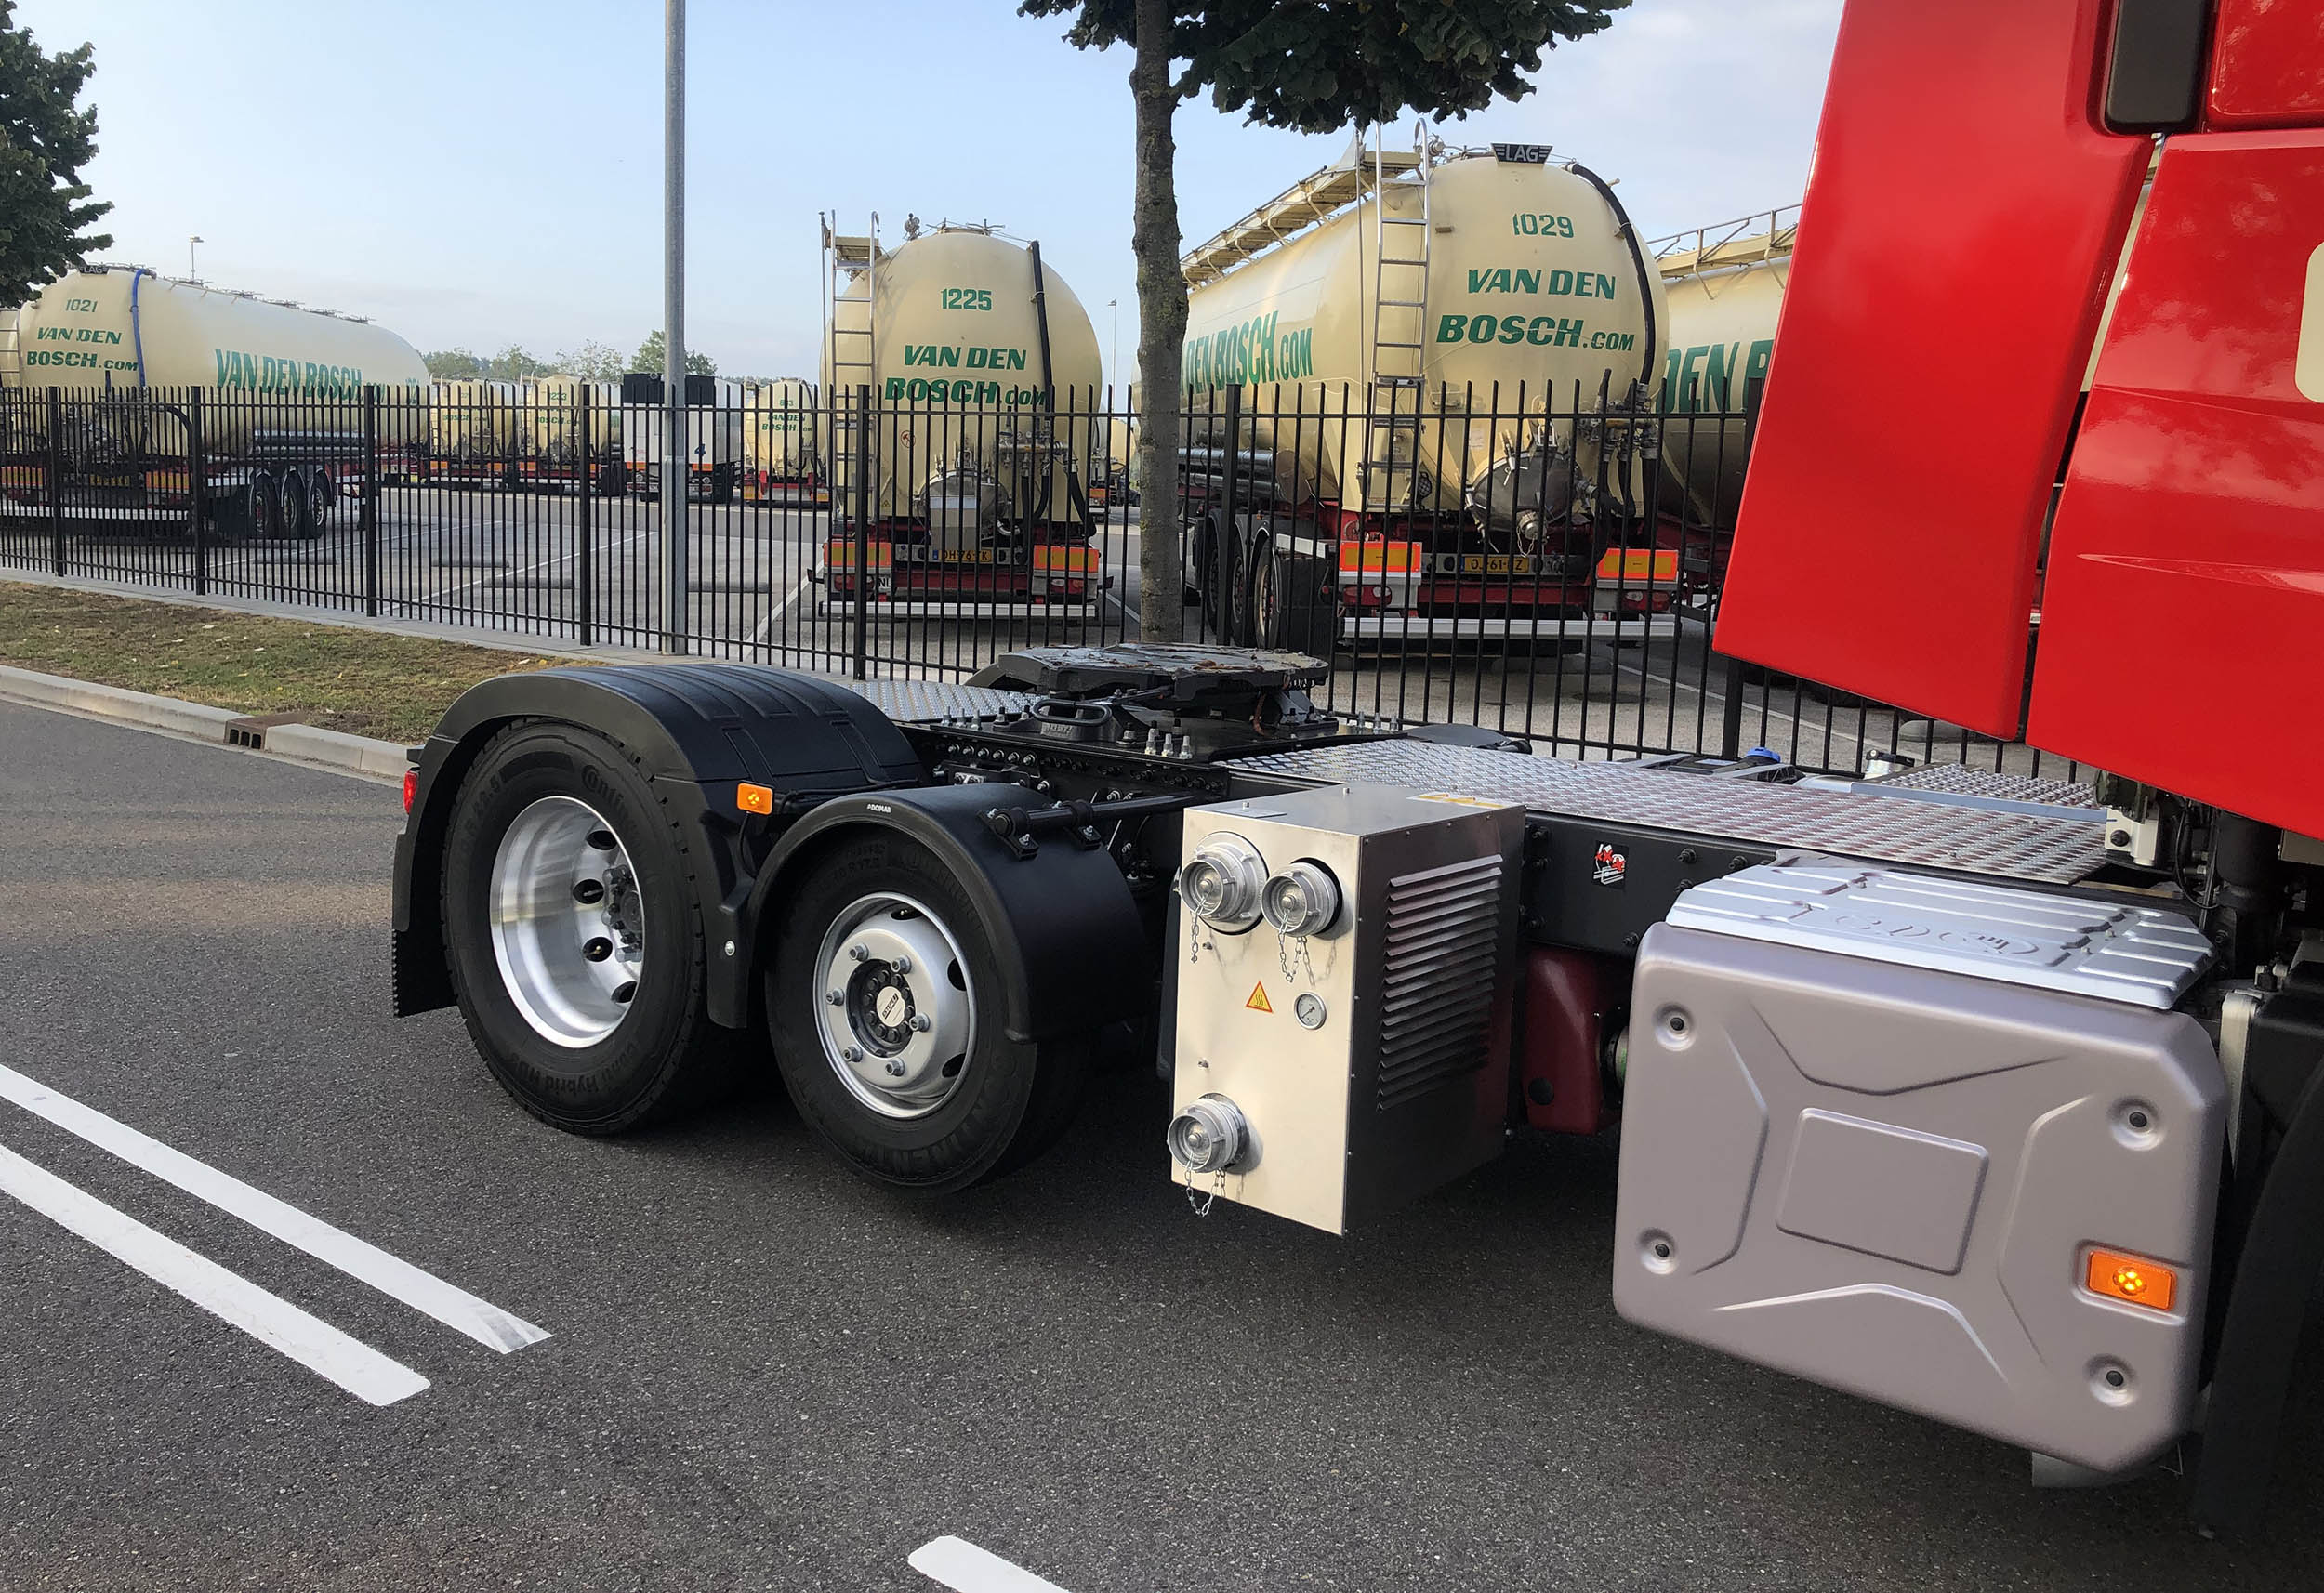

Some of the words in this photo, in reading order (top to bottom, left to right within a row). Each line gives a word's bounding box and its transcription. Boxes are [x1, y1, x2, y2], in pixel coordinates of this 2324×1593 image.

[1505, 146, 1538, 163] LAG
[1512, 213, 1574, 238] 1029
[1468, 268, 1541, 294] VAN
[1548, 270, 1616, 299] DEN
[65, 299, 98, 312] 1021
[941, 288, 992, 311] 1225
[37, 327, 73, 341] VAN
[76, 329, 122, 344] DEN
[905, 345, 961, 367] VAN
[966, 347, 1027, 370] DEN
[215, 349, 257, 390] VAN
[263, 356, 301, 395] DEN
